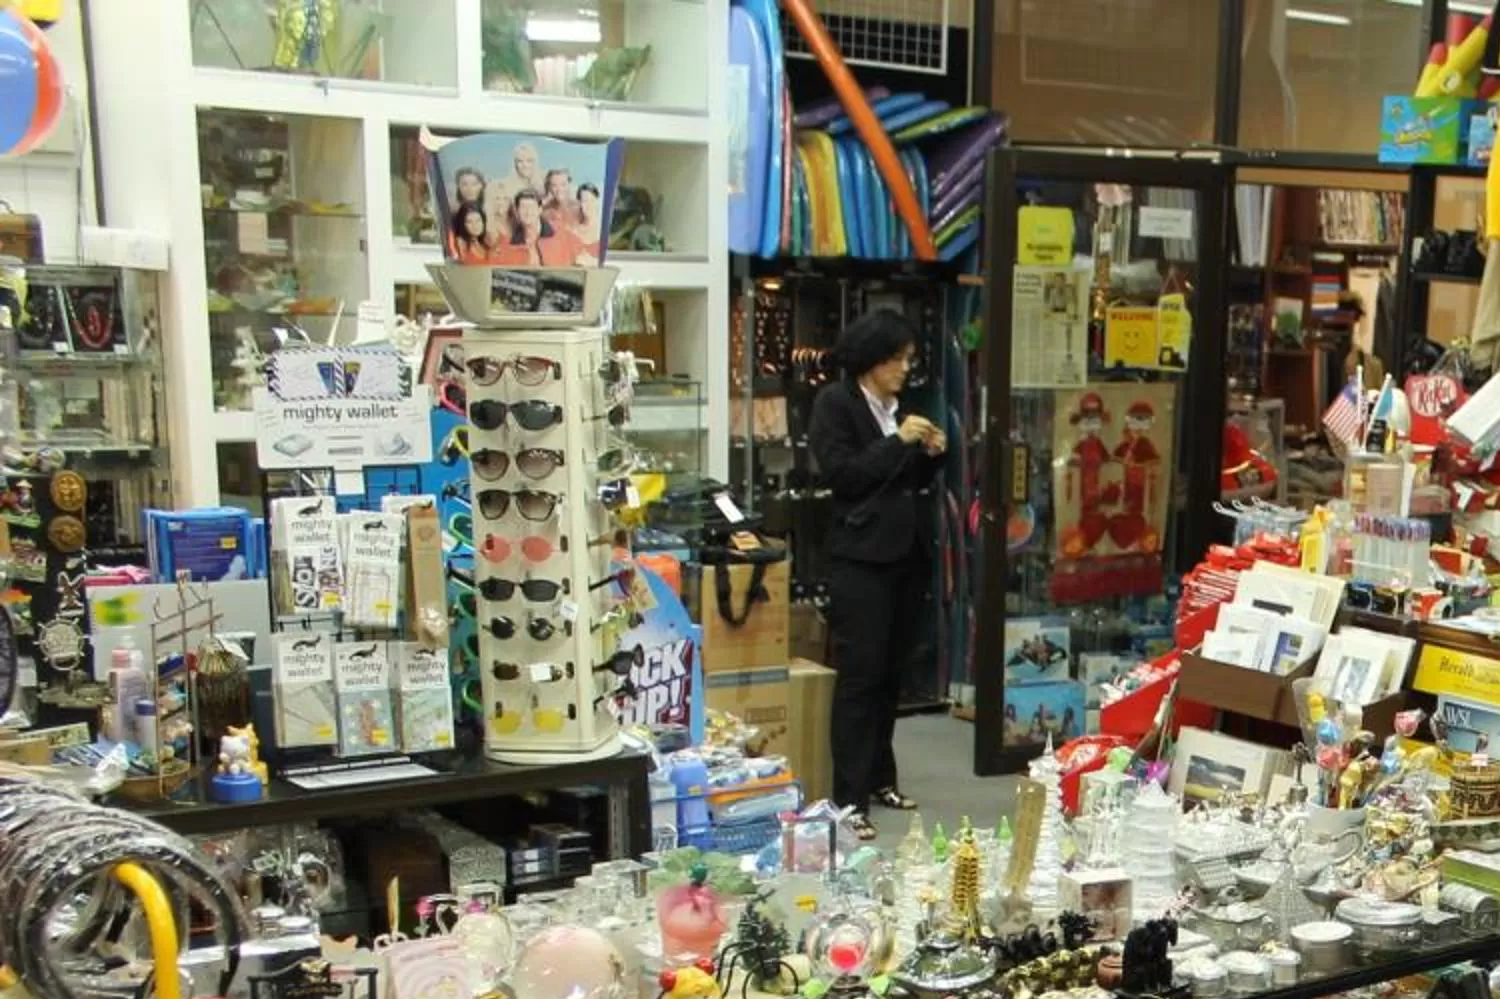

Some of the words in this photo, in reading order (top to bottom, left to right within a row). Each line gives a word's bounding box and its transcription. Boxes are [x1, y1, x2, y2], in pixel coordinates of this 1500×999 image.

[283, 404, 342, 422] mighty
[347, 403, 399, 419] wallet
[341, 660, 382, 673] mighty
[407, 660, 446, 673] mighty
